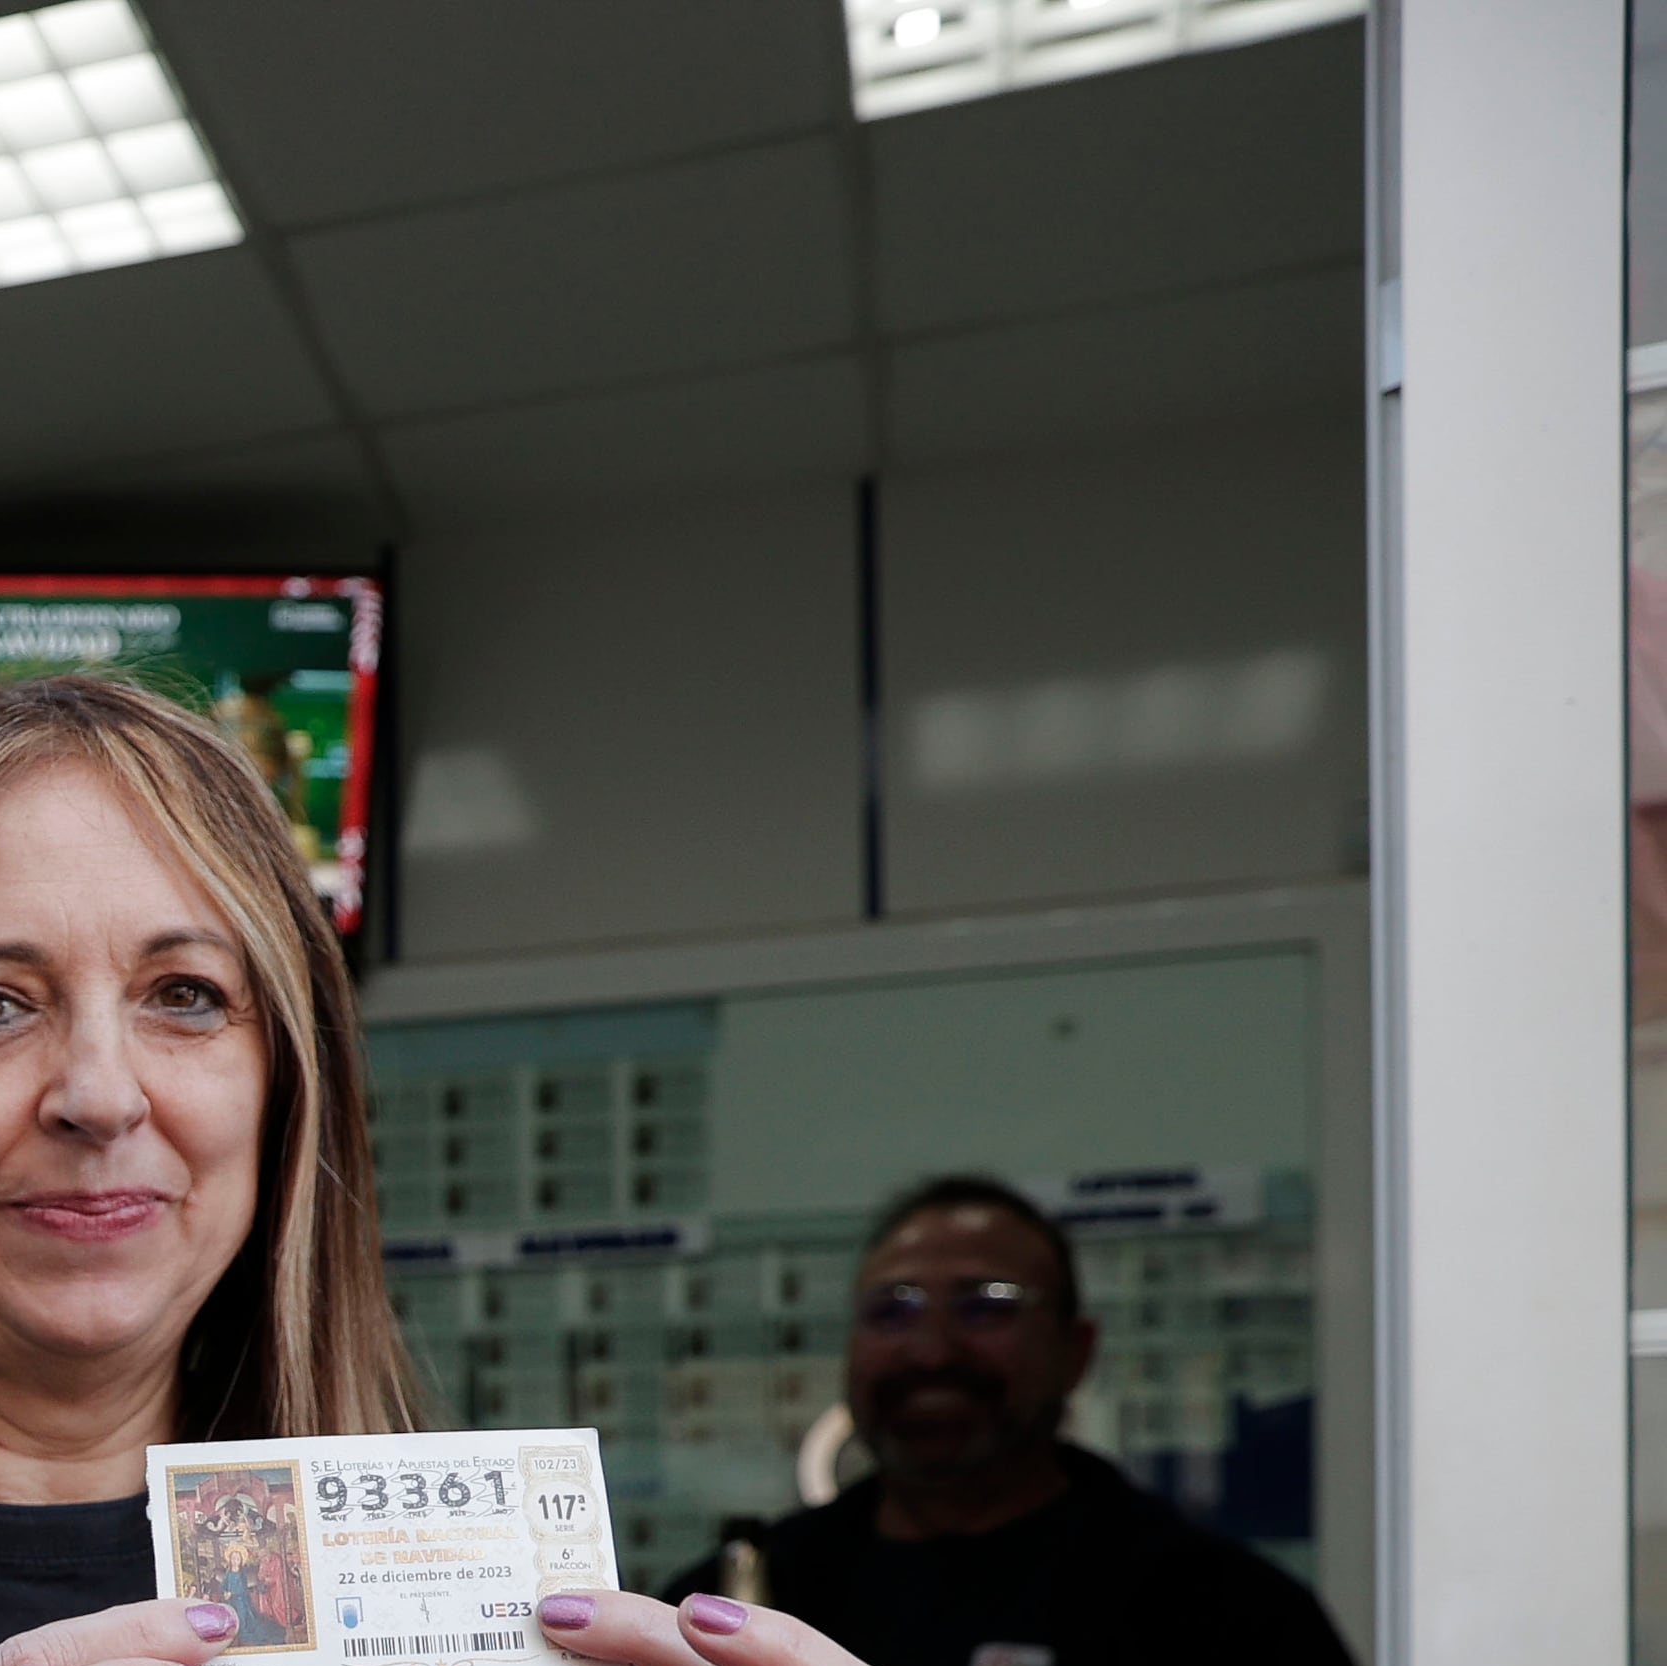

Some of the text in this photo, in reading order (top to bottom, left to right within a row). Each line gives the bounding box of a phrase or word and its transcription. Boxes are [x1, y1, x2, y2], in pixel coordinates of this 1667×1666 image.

[533, 1458, 578, 1471] 102/23
[317, 1470, 507, 1514] 93361
[322, 1524, 519, 1548] LOTERÍA NACIONAL
[554, 1524, 576, 1533] SERIE
[360, 1548, 486, 1566] DE NAVIDAD
[338, 1566, 512, 1585] 22 de diciembre de 2023
[480, 1601, 533, 1619] UE23
